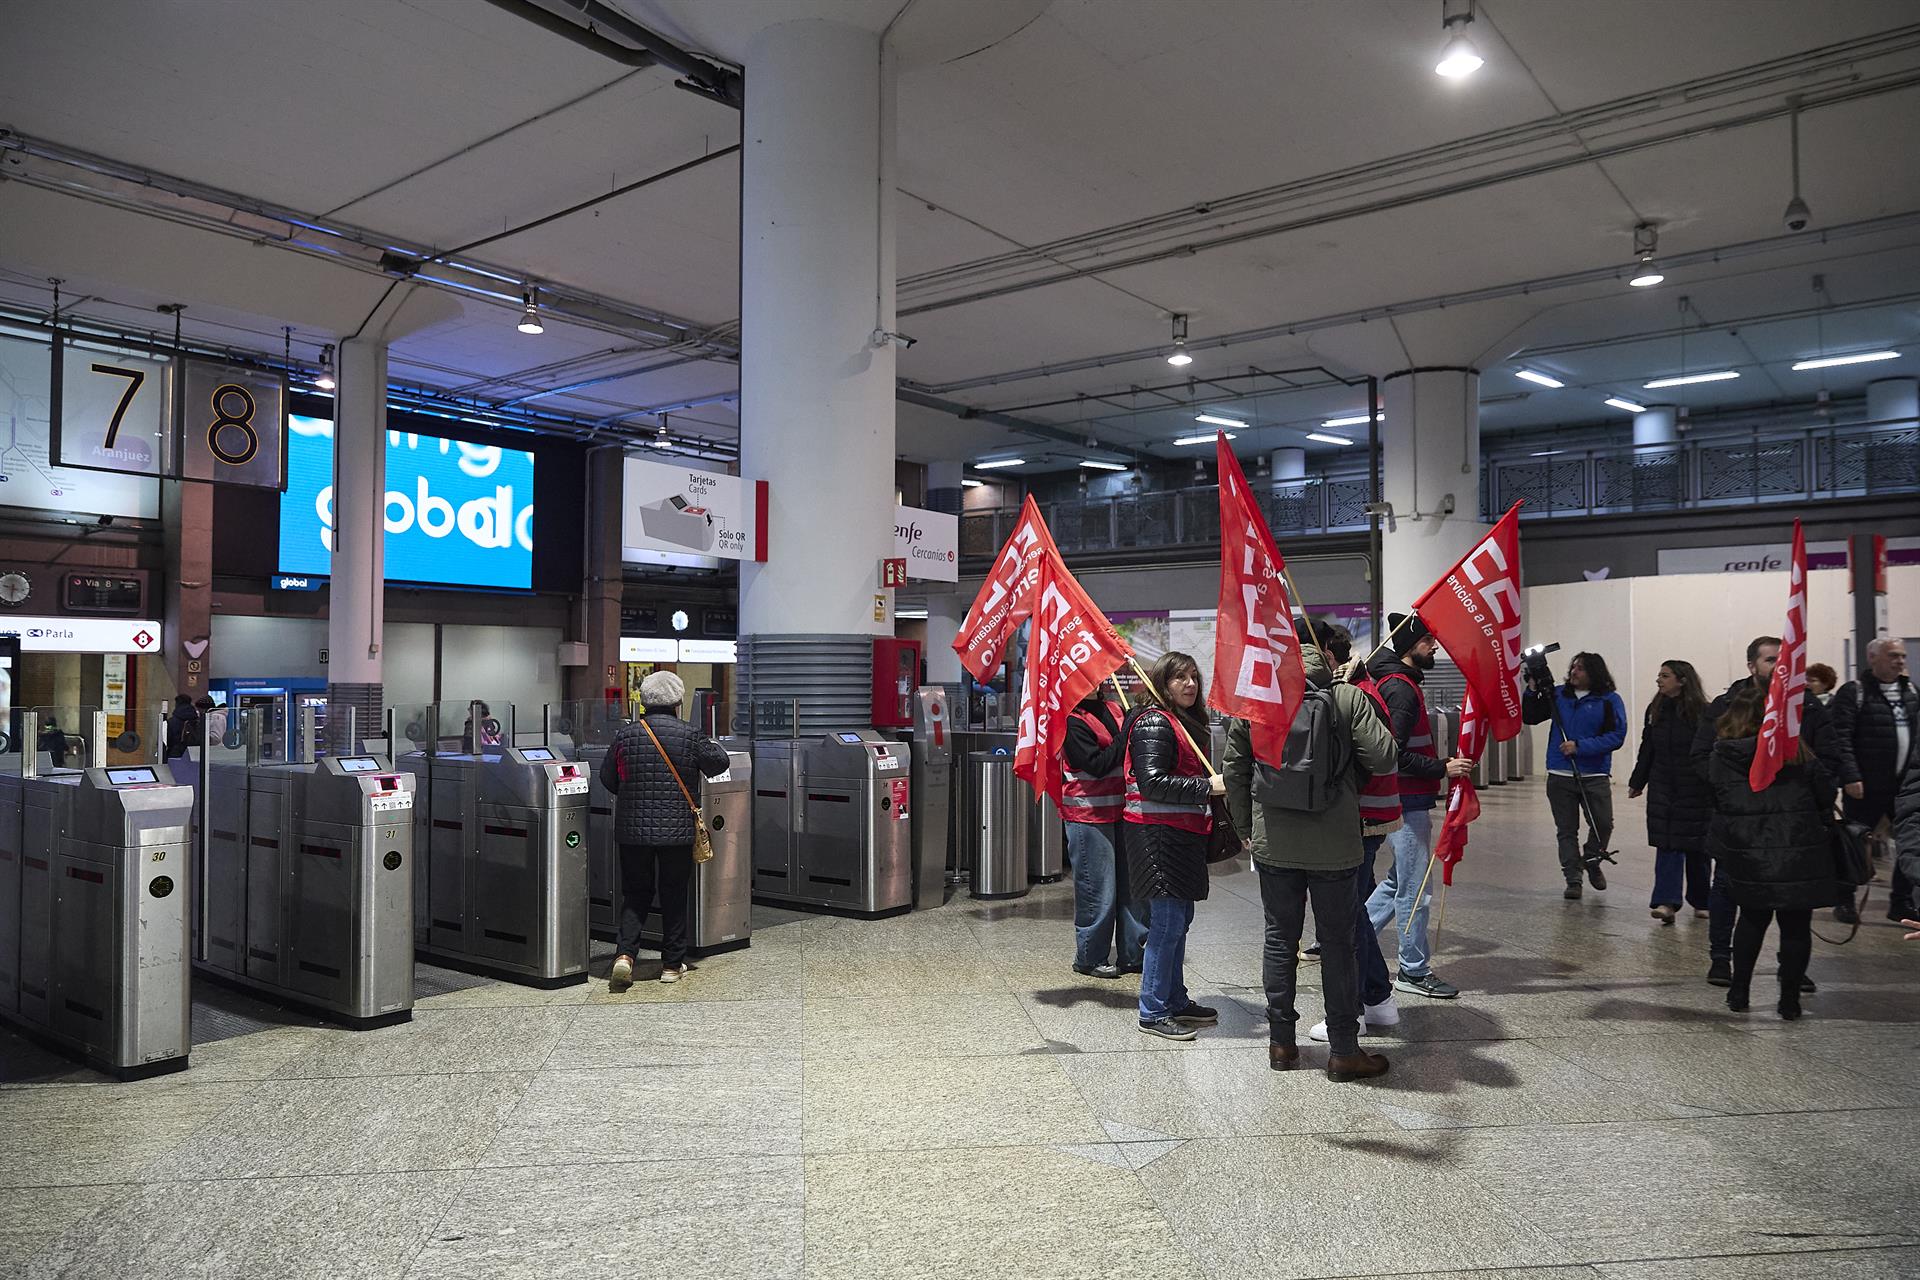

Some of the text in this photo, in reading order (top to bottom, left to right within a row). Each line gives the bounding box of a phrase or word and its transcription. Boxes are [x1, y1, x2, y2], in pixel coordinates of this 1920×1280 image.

[91, 363, 145, 449] 7
[206, 383, 259, 465] 8
[92, 445, 150, 463] Aranjuez
[689, 473, 717, 487] Tarjetas
[688, 483, 708, 495] Cards
[718, 529, 746, 542] Solo QR
[894, 521, 923, 545] enfe
[718, 539, 744, 553] QR only
[1725, 554, 1782, 572] renfe
[105, 580, 112, 588] 8
[280, 578, 308, 588] global
[1446, 573, 1478, 617] ervicios
[1474, 610, 1484, 622] a
[1481, 623, 1494, 637] la
[45, 629, 74, 638] Parla
[138, 633, 149, 646] 8
[566, 812, 576, 821] 32
[385, 830, 396, 839] 31
[152, 851, 166, 862] 30
